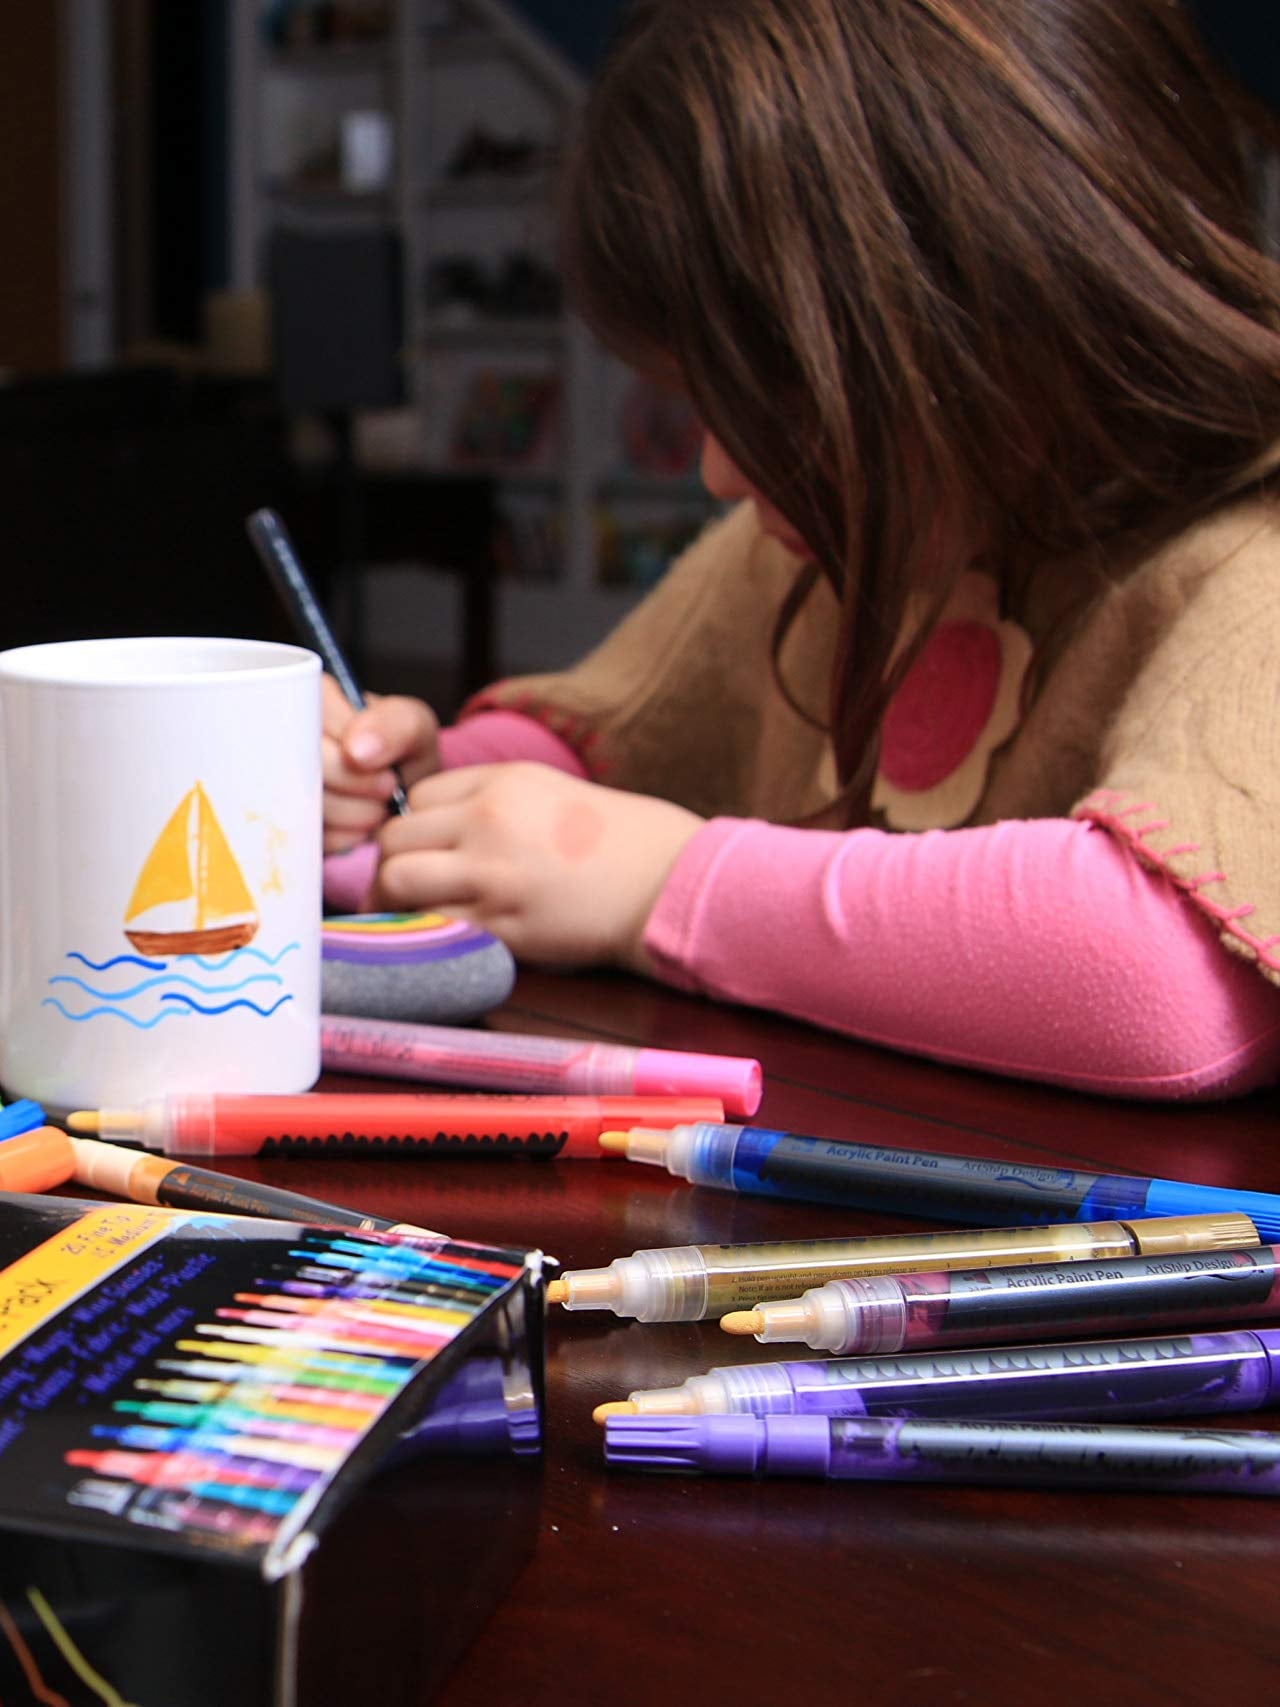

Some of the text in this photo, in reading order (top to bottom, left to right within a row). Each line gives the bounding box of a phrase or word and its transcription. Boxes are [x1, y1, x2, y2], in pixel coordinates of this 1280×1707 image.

[826, 1144, 871, 1161] Acrylic
[874, 1150, 910, 1165] Paint
[913, 1155, 939, 1169] Pen
[1007, 1268, 1124, 1289] Acrylic Paint Pen
